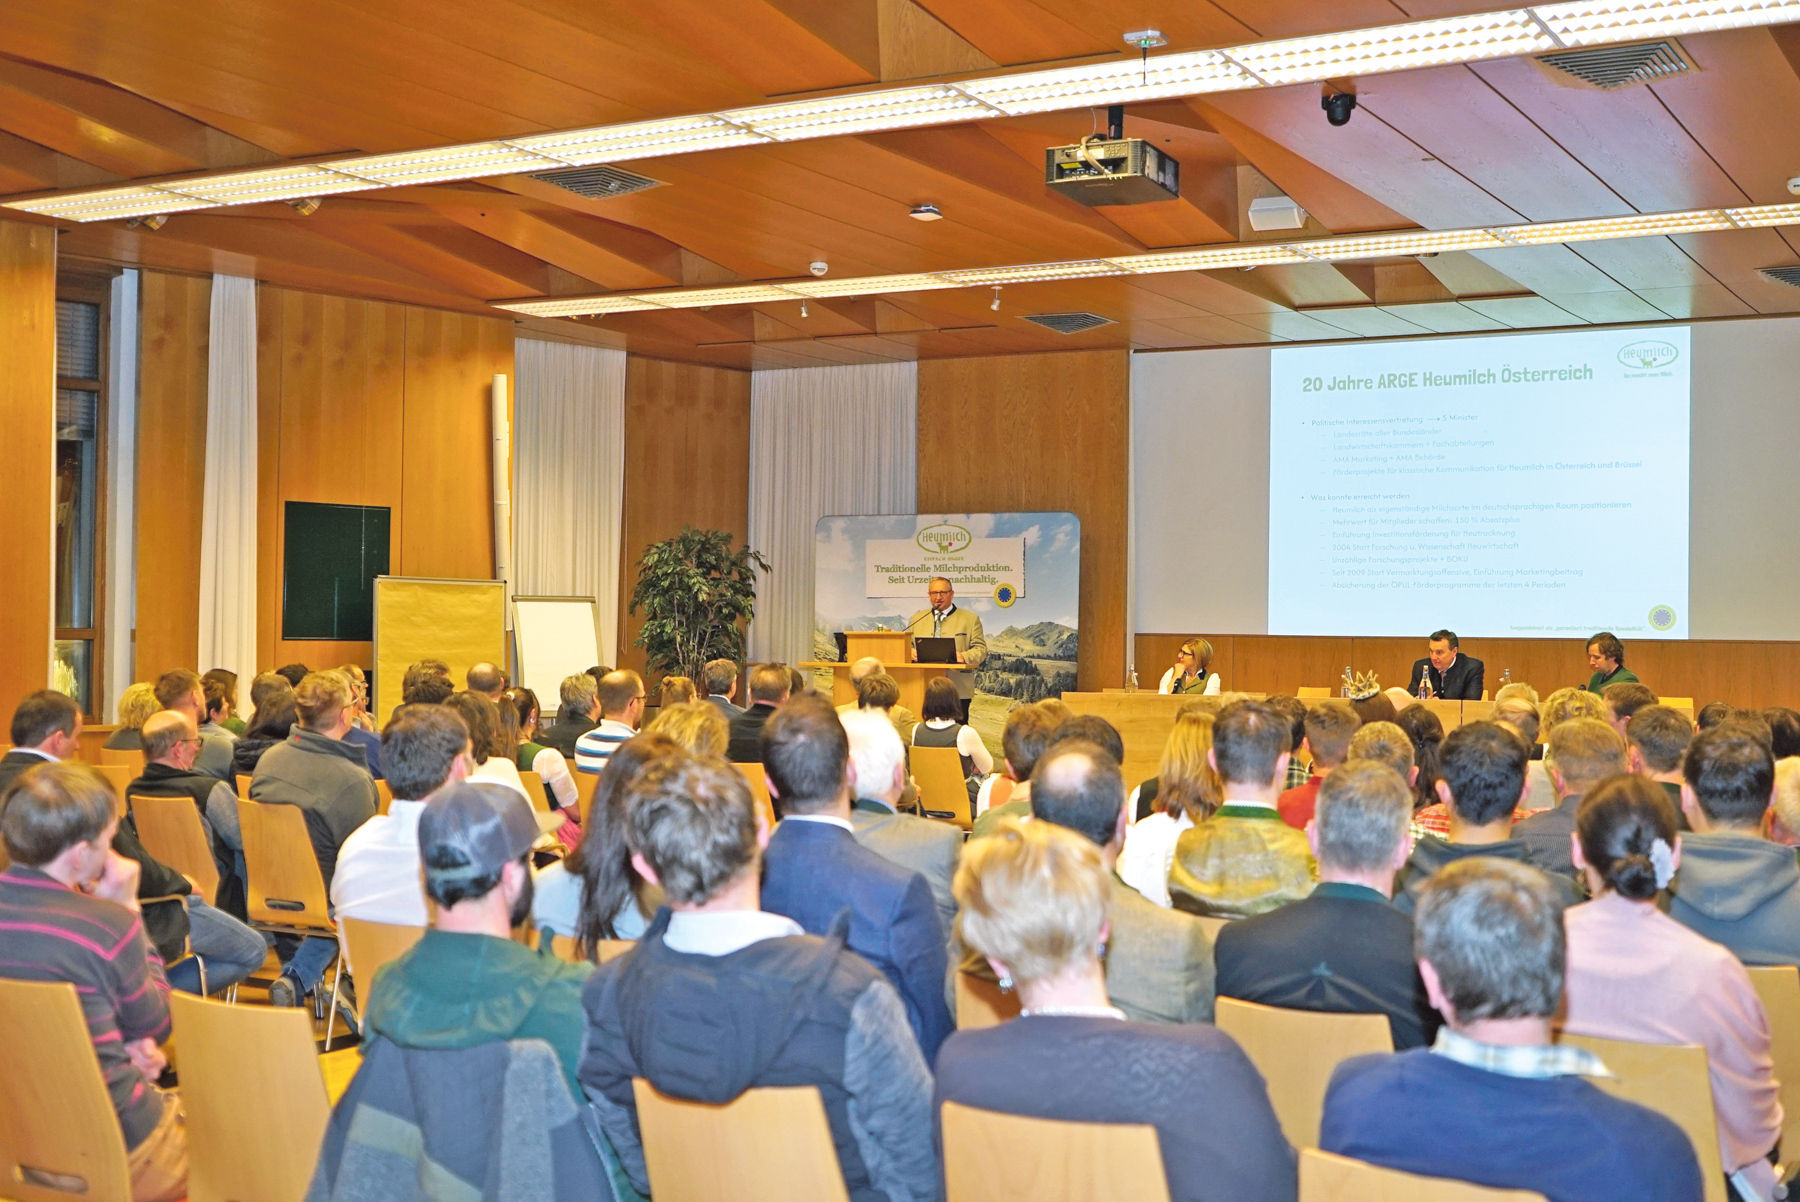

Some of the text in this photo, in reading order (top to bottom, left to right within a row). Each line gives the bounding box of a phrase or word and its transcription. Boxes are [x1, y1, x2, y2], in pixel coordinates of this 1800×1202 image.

[1302, 363, 1593, 392] 20 Jahre ARGE Heumilch Österreich
[1598, 461, 1613, 469] und
[922, 530, 966, 543] Heumilch
[874, 563, 1013, 574] Traditionelle Milchproduktion.
[887, 575, 906, 584] Seit
[950, 574, 998, 585] nachhaltig.
